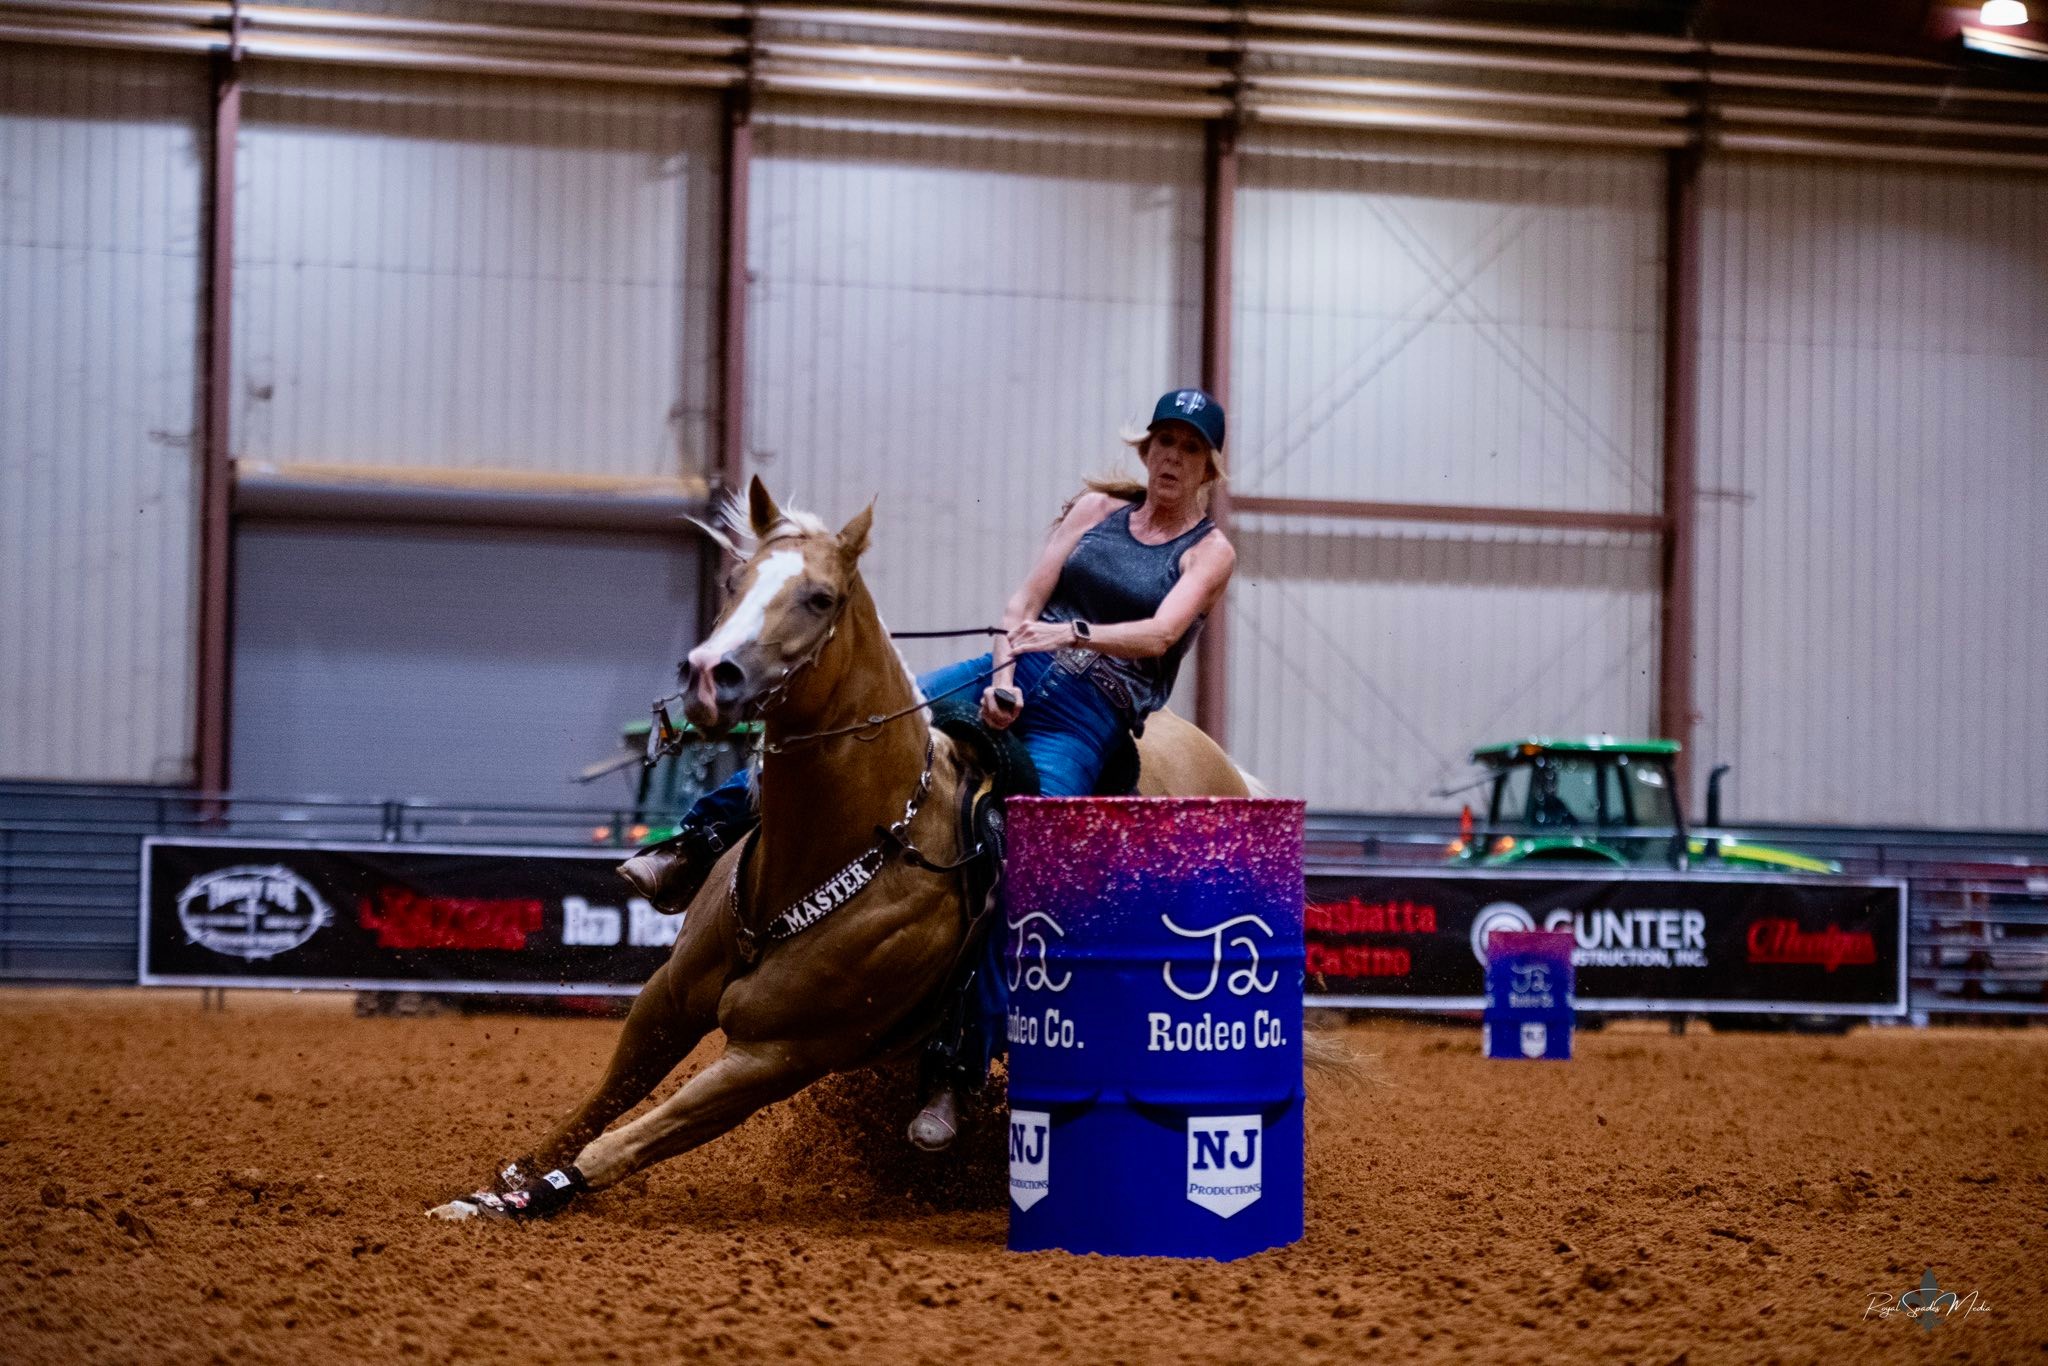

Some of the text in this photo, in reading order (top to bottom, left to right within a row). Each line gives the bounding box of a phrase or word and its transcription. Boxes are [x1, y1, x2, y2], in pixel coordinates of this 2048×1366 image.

[783, 863, 871, 932] MASTER
[1304, 896, 1437, 934] ushatta
[1044, 1007, 1084, 1048] Co.
[1148, 1010, 1287, 1051] Rodeo Co.
[1010, 1123, 1047, 1165] NJ
[1193, 1129, 1258, 1169] NJ
